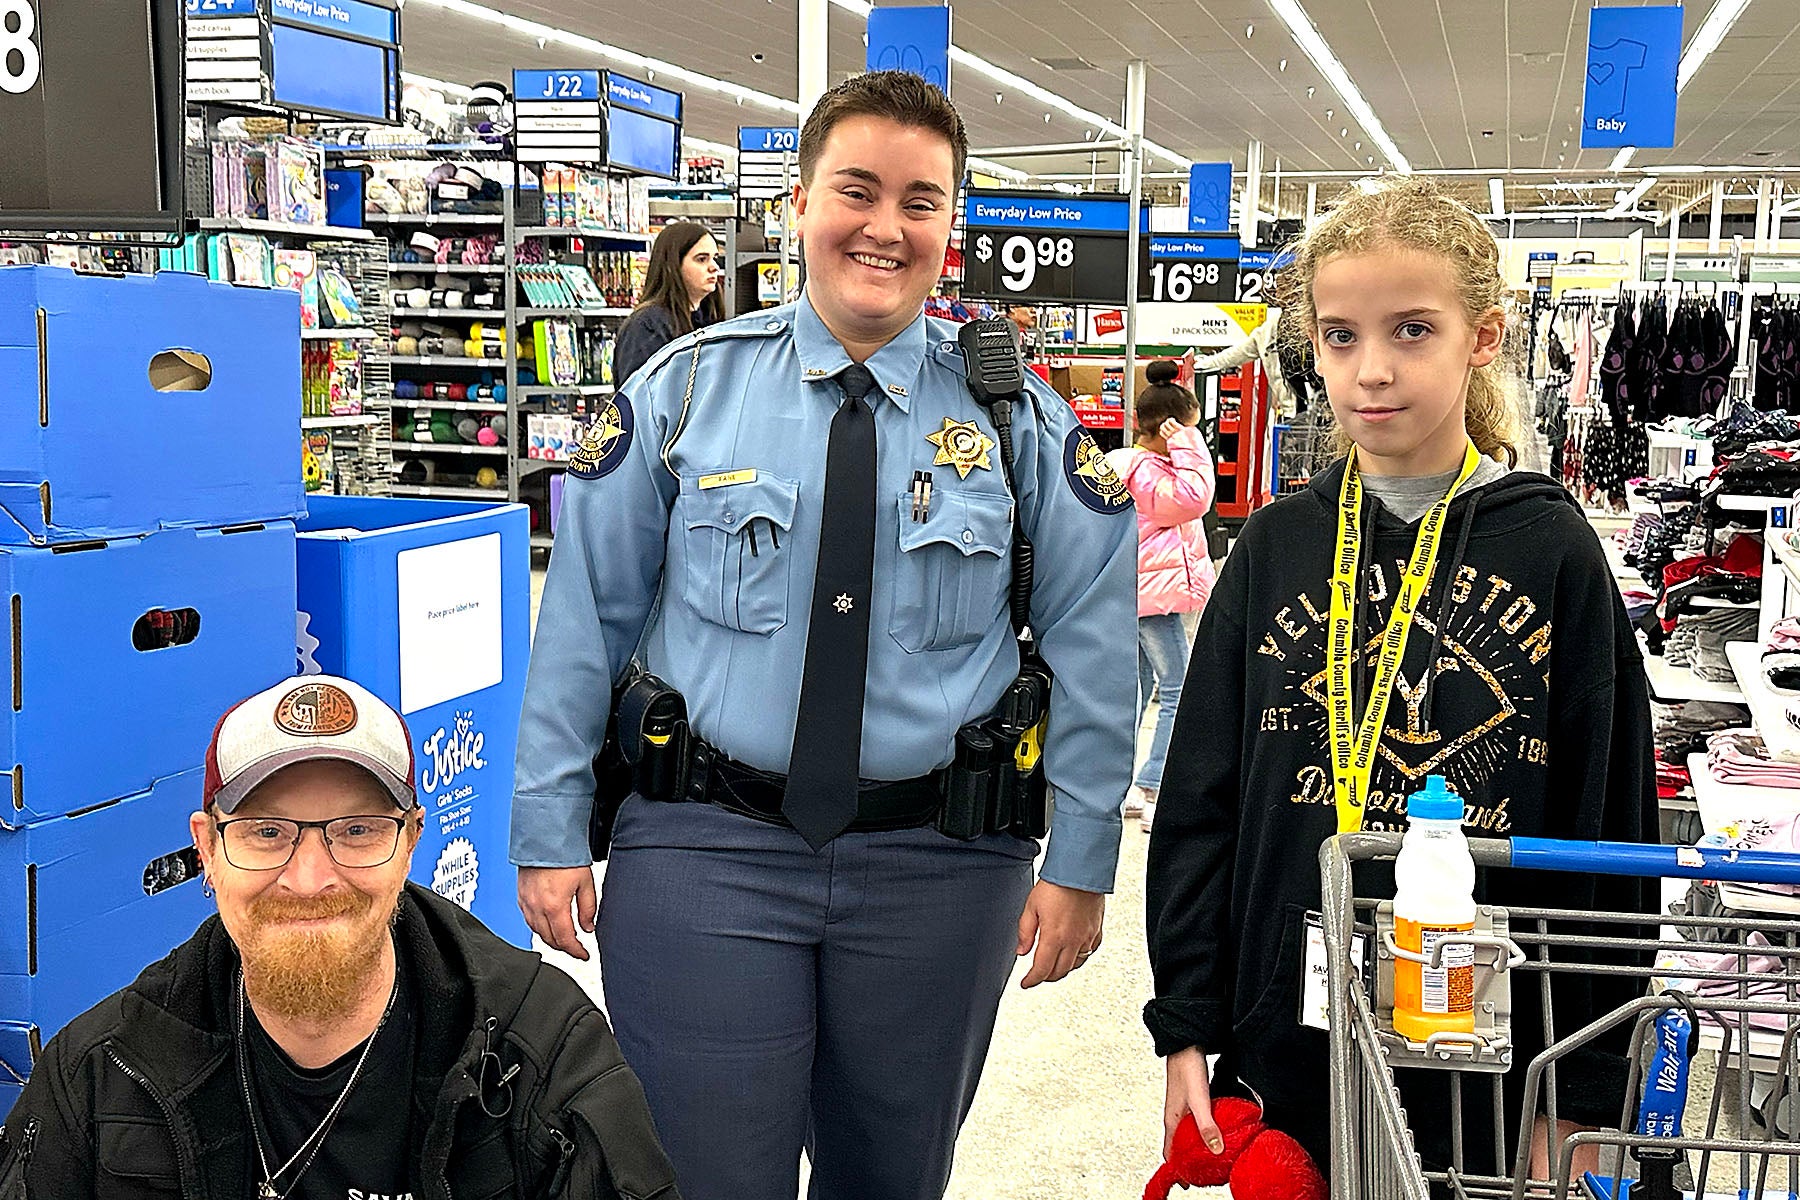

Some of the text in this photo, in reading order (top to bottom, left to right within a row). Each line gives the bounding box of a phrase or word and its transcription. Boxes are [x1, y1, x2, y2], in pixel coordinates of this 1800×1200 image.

[313, 3, 330, 18] Low
[331, 5, 350, 23] Price
[0, 0, 40, 94] 8
[1596, 118, 1627, 134] Baby
[763, 131, 795, 149] J20
[976, 204, 1082, 221] Everyday Low Price
[975, 233, 993, 264] $
[1150, 243, 1205, 254] day Low Price
[1097, 317, 1122, 328] Hanes
[1172, 327, 1228, 335] 12 PACK SOCKS
[1202, 319, 1228, 327] MEN'S
[1411, 502, 1447, 577] Columbia County
[1340, 547, 1356, 575] Office
[1332, 618, 1352, 769] Columbia County Sheriff's Office
[1354, 621, 1404, 769] Columbia County Sheriff's Office
[454, 785, 473, 801] Socks
[441, 852, 470, 877] WHILE
[435, 867, 475, 895] SUPPLIES
